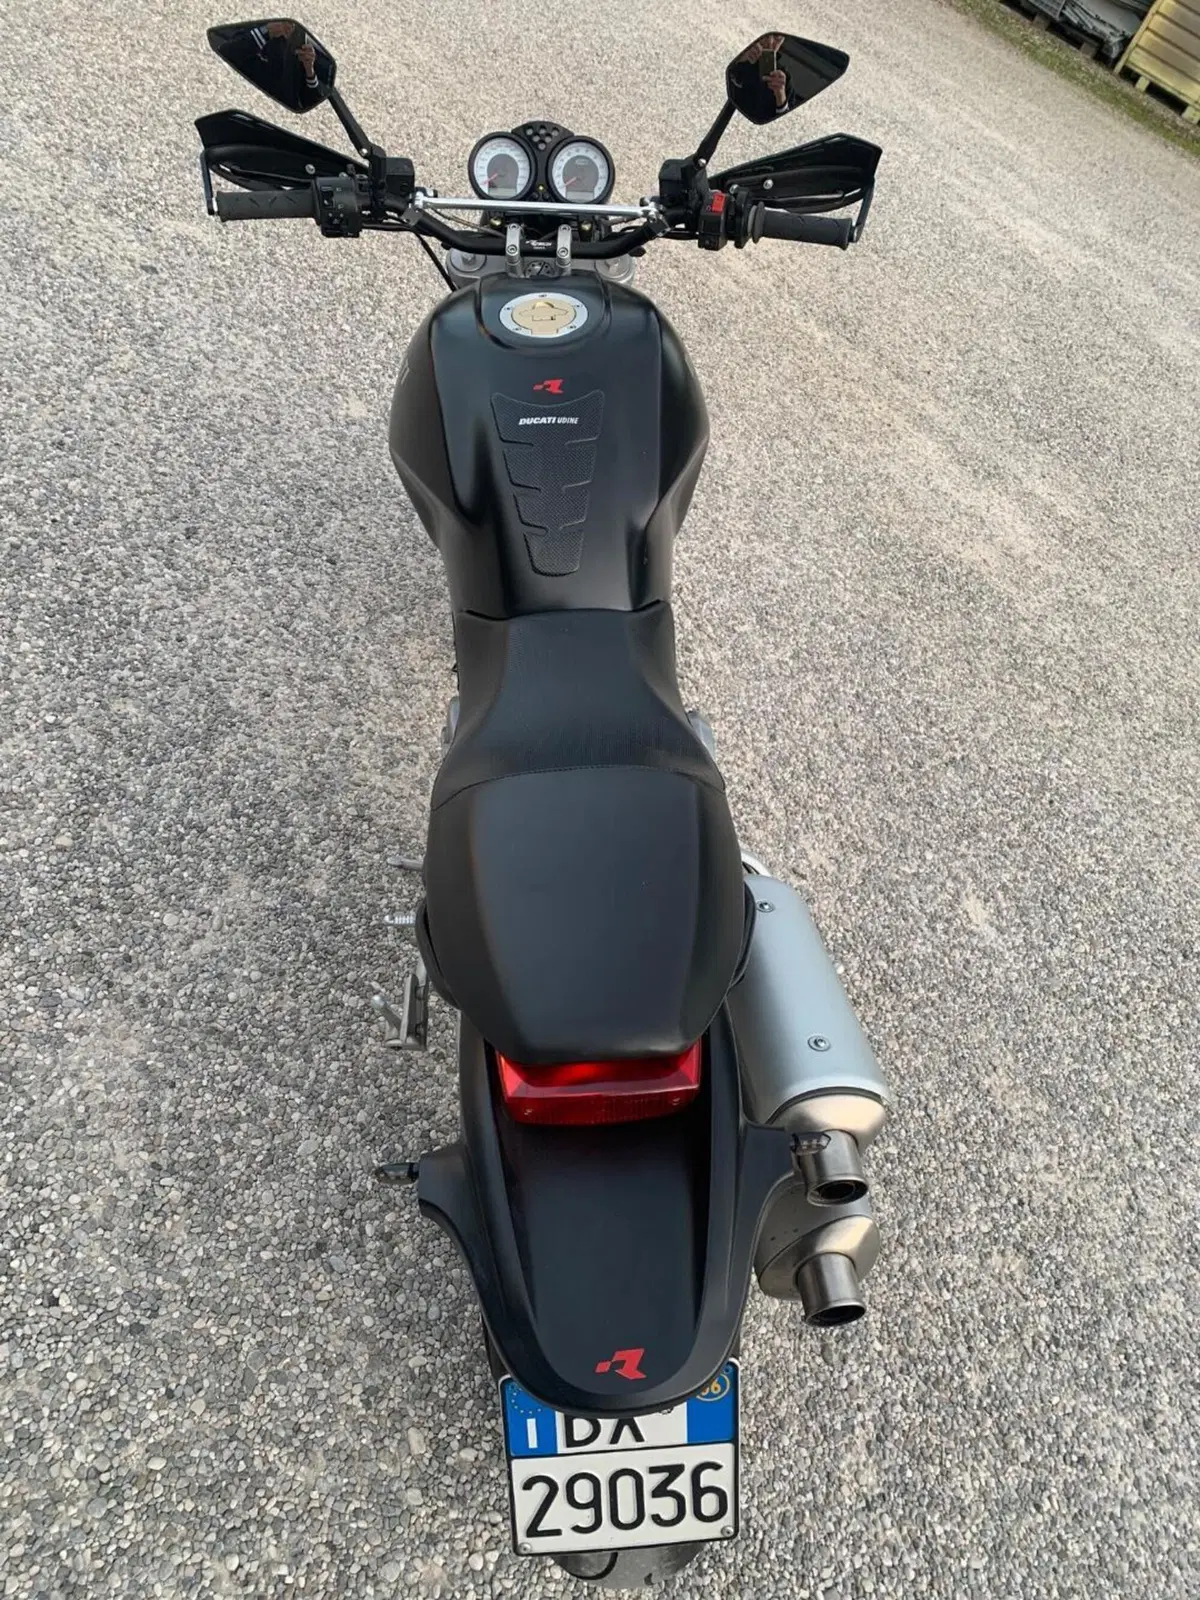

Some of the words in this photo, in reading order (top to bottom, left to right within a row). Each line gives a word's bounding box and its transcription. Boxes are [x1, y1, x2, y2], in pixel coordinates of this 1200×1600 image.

[518, 416, 557, 425] DUCATI
[557, 417, 579, 425] UDINE
[521, 1461, 728, 1538] 29036
